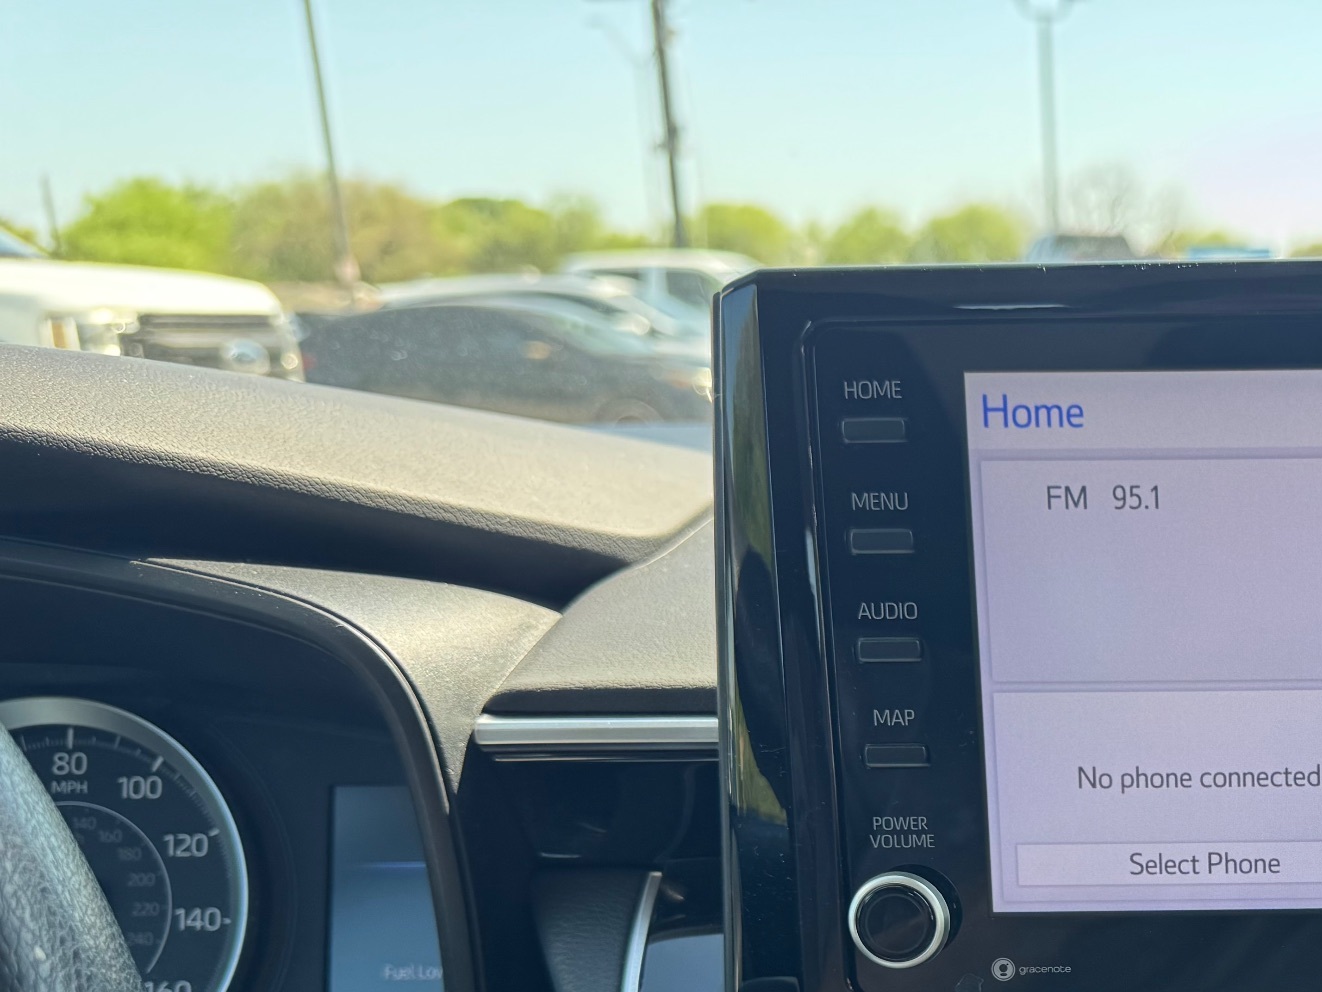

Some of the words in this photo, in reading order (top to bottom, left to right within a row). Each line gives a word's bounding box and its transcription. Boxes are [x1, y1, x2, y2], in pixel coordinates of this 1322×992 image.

[844, 380, 903, 400] HOME
[982, 393, 1085, 430] Home
[852, 492, 909, 511] MENU
[1046, 486, 1089, 511] FM
[1112, 484, 1161, 511] 95.1
[858, 602, 919, 621] AUDIO
[873, 709, 916, 727] MAP
[52, 752, 88, 776] 80
[51, 780, 88, 795] MPH
[117, 775, 163, 800] 100
[1077, 766, 1114, 790] No
[1120, 766, 1193, 795] phone
[872, 816, 929, 832] POWER
[163, 833, 209, 858] 120
[870, 834, 935, 849] VOLUME
[1129, 852, 1200, 876] Select
[1207, 852, 1281, 875] Phone
[175, 907, 222, 932] 140
[1019, 966, 1072, 976] gracenote
